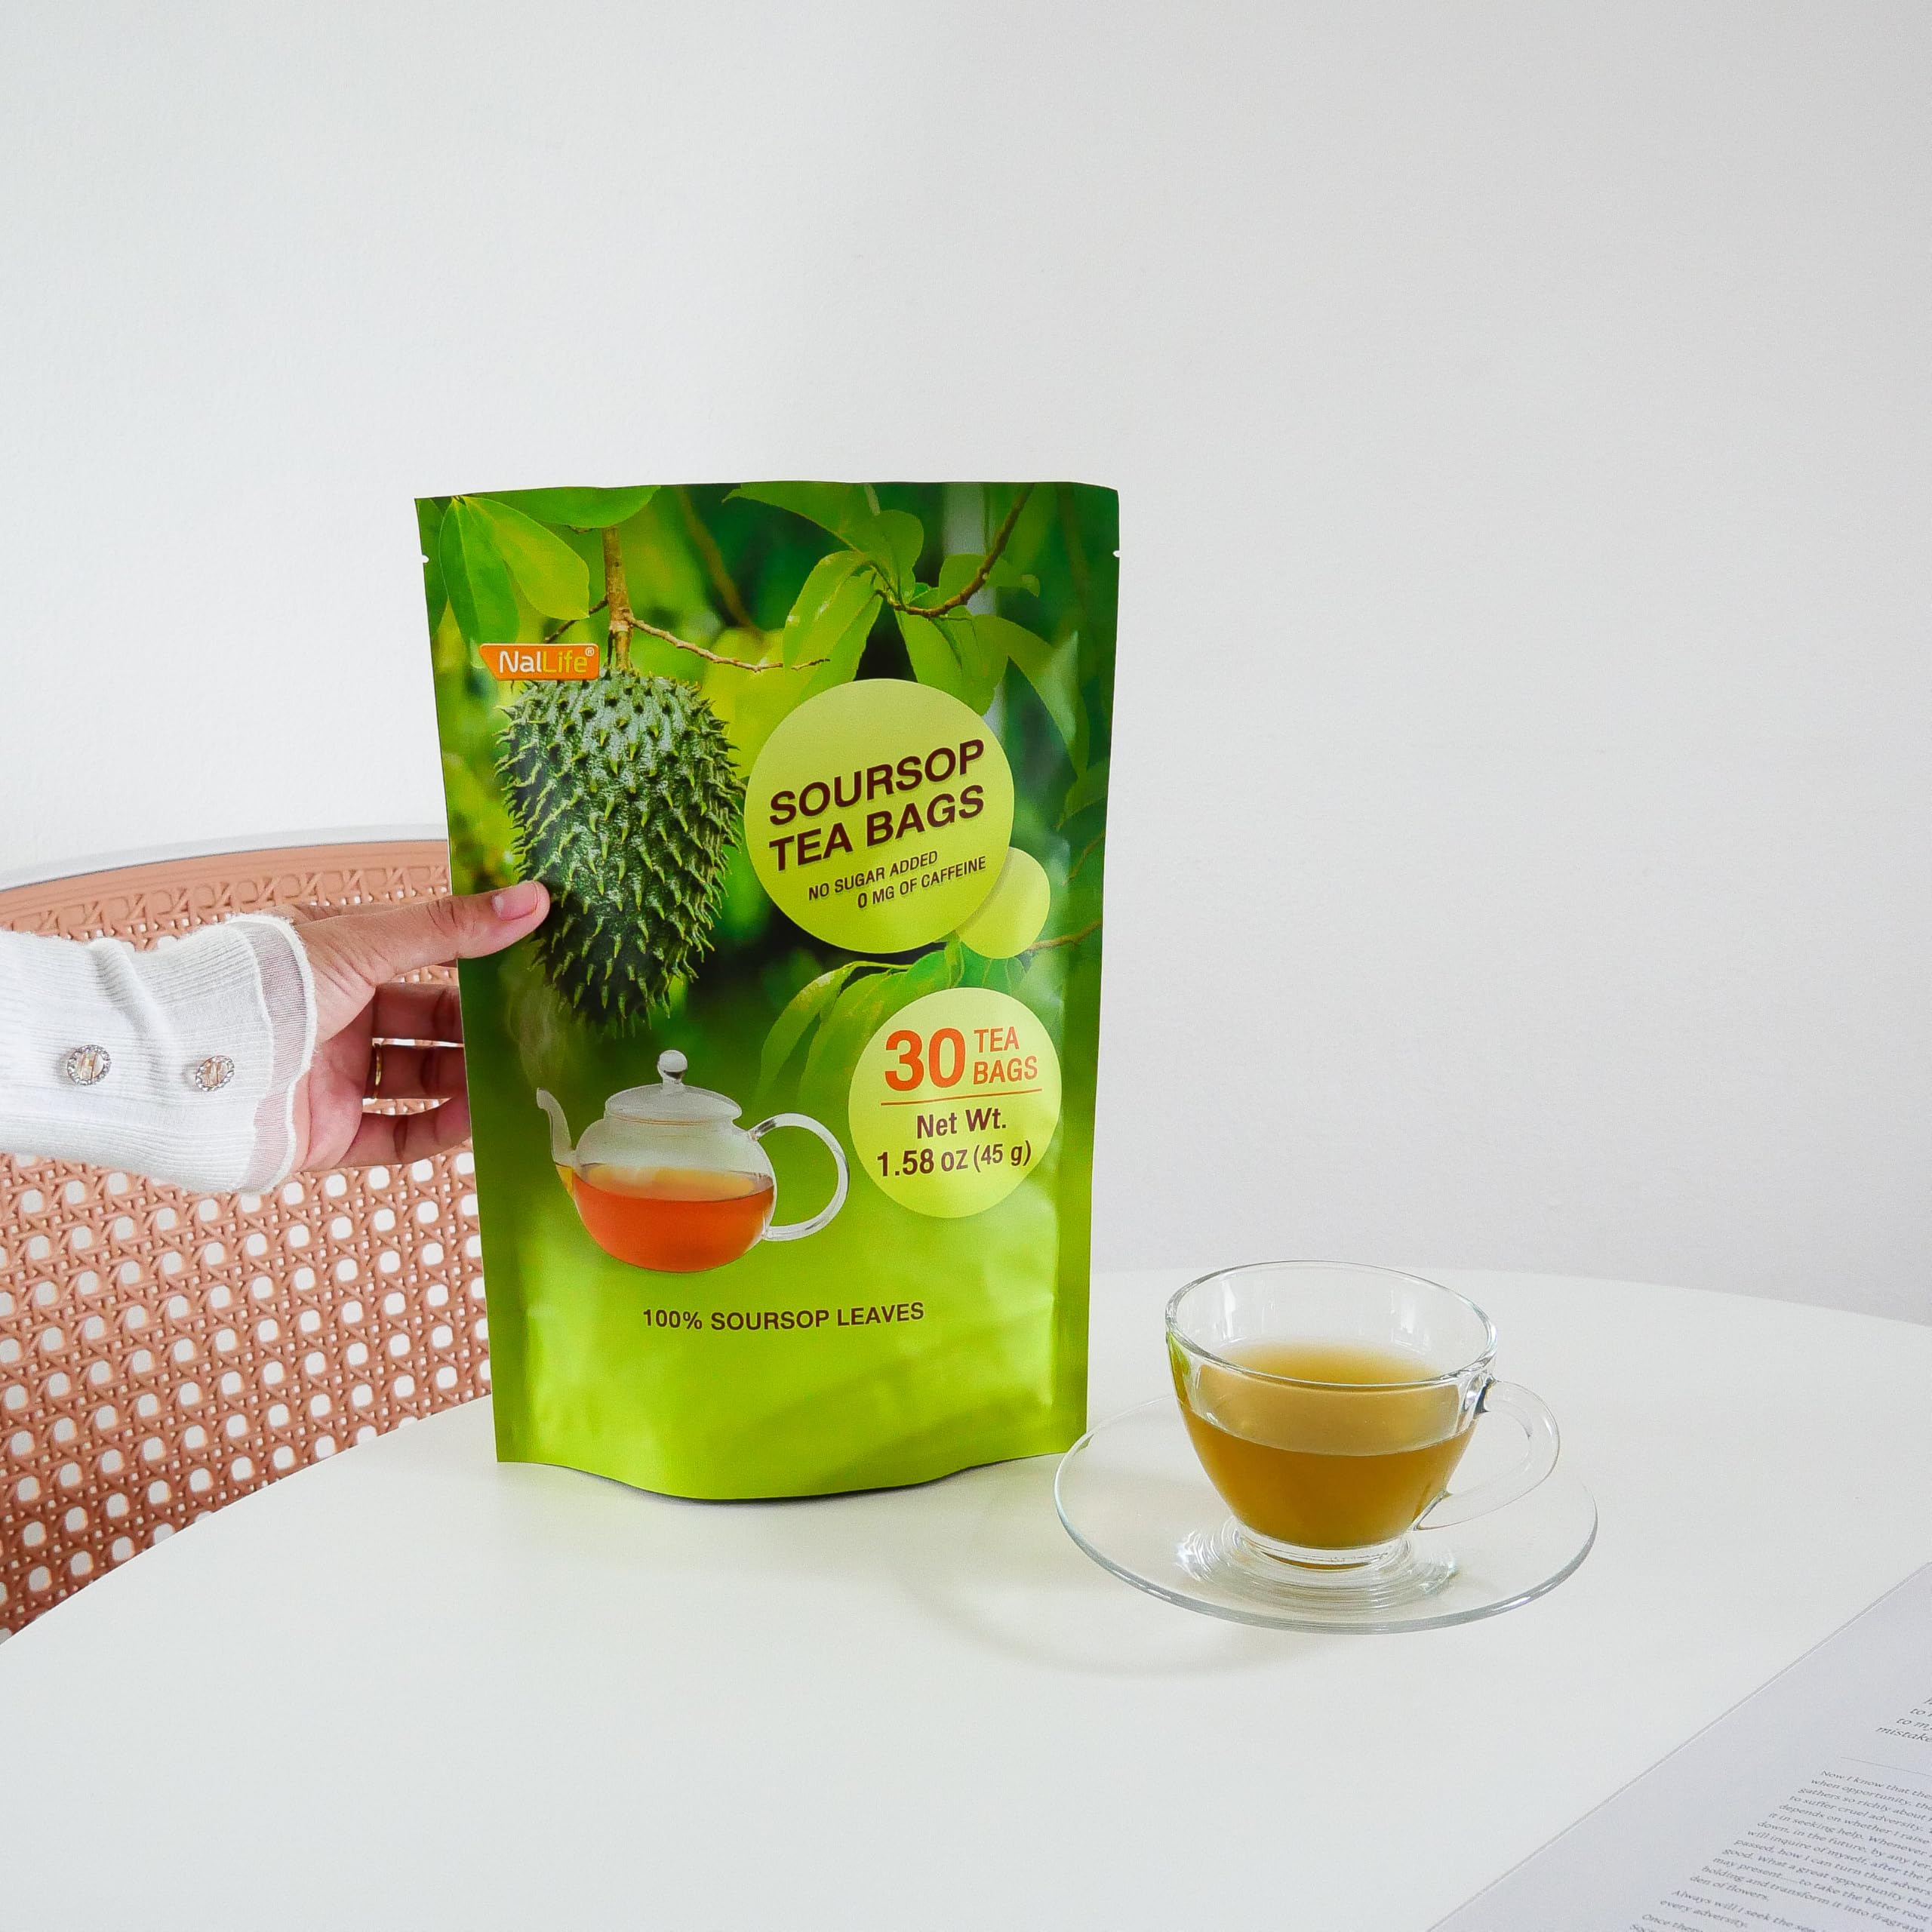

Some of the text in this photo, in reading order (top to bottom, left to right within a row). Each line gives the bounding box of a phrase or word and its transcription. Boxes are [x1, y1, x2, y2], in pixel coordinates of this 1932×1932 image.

[769, 739, 985, 826] SOURSOP
[769, 785, 985, 872] TEA BAGS
[808, 851, 938, 900] NO SUGAR ADDED
[857, 856, 986, 909] 0 MG OF CAFFEINE
[884, 1026, 1020, 1091] 30 TEA
[973, 1055, 1038, 1085] BAGS
[917, 1107, 1007, 1139] Net Wt.
[877, 1140, 1032, 1177] 1.58 oz (45 g)
[643, 1302, 924, 1331] 100% SOURSOP LEAVES
